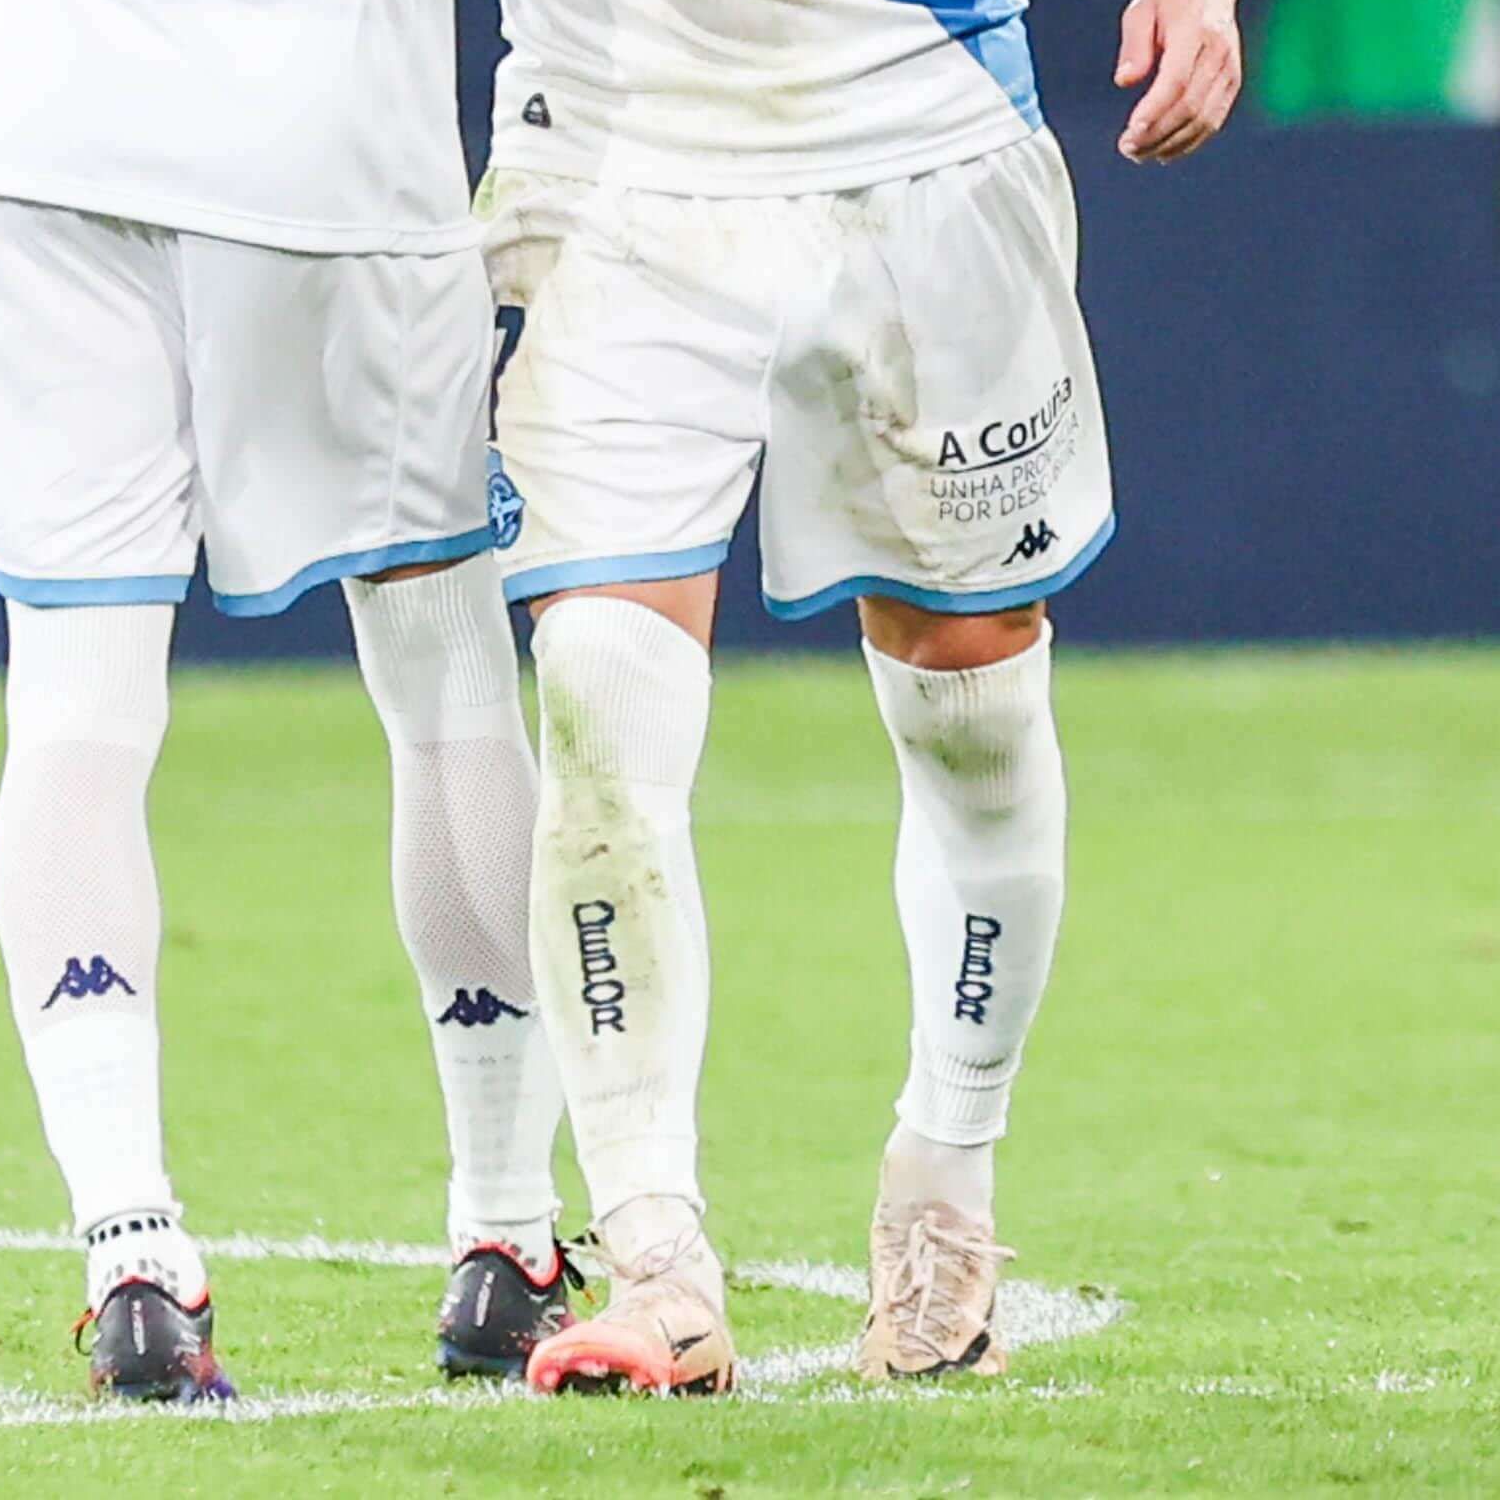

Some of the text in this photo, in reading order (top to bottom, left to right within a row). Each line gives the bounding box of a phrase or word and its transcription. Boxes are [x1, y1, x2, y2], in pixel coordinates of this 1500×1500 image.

[938, 431, 968, 467] A
[930, 473, 1005, 499] UNHA
[939, 501, 992, 523] POR
[573, 900, 626, 1035] DEPOR
[954, 913, 1002, 1025] DEPOR
